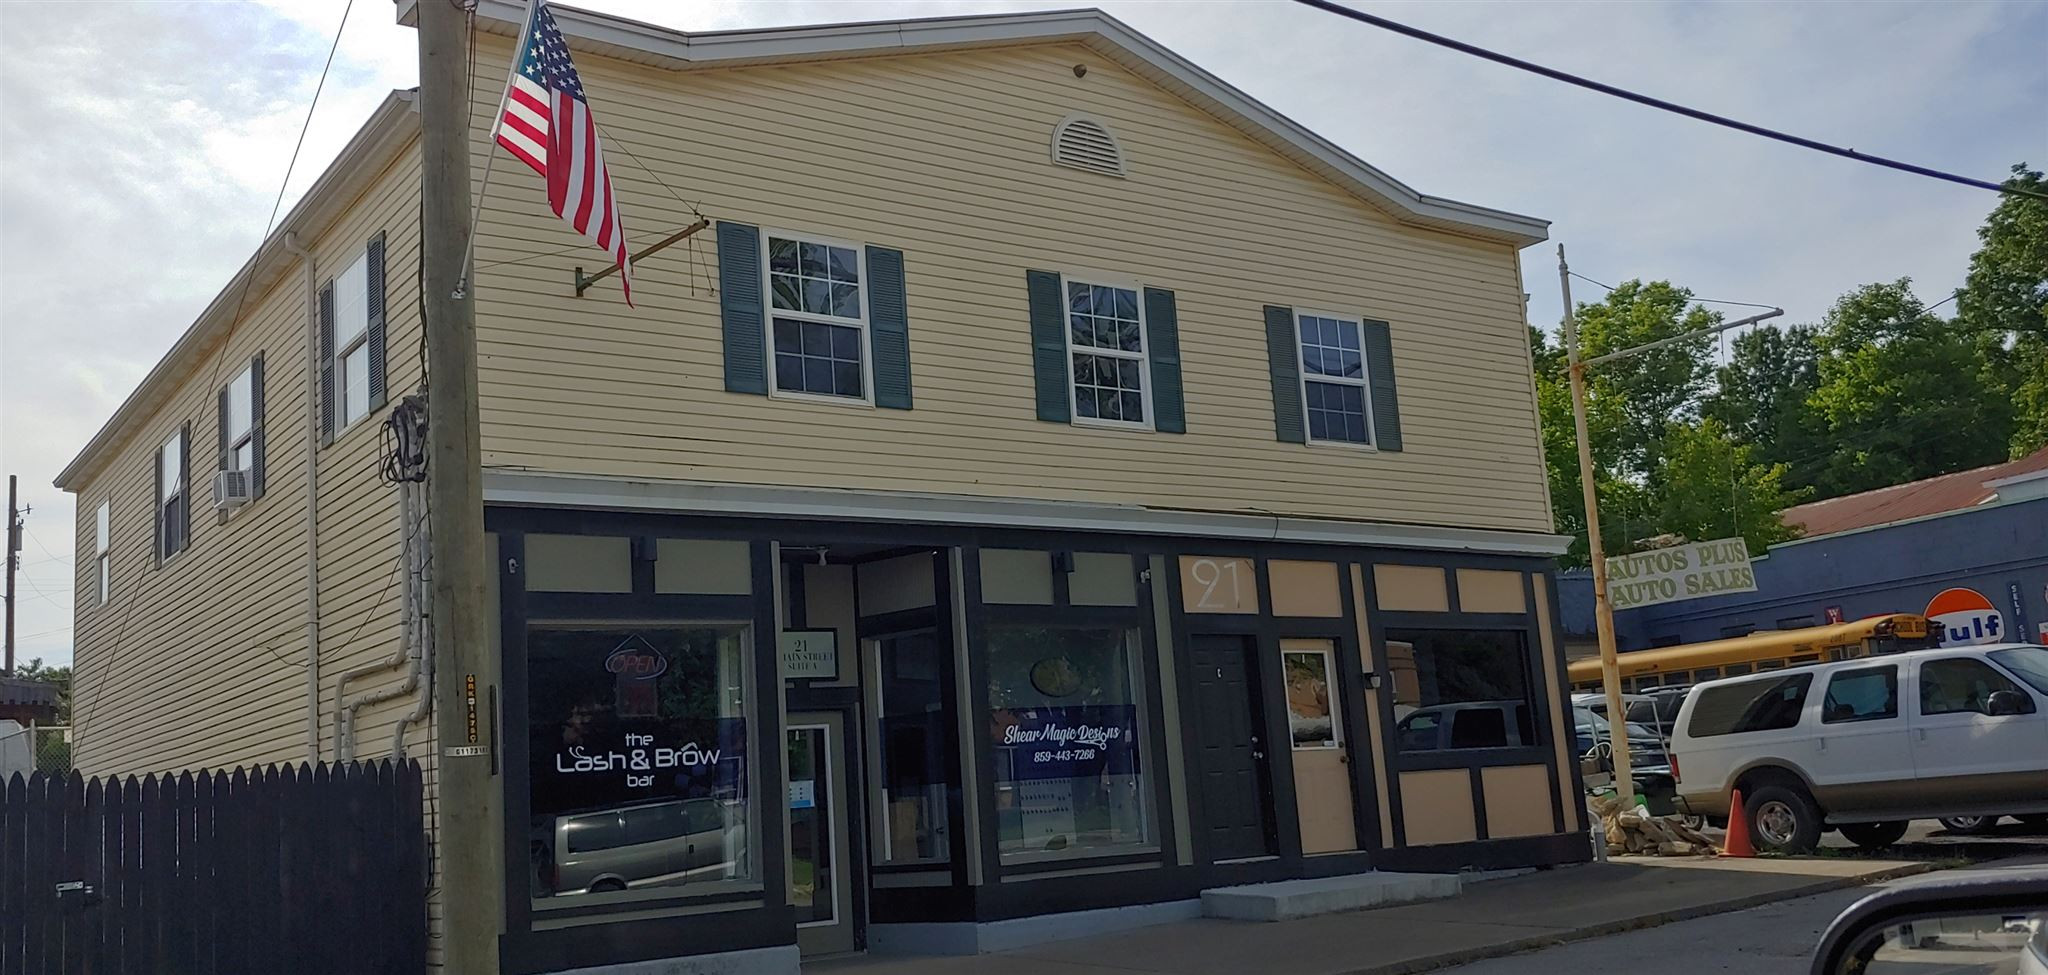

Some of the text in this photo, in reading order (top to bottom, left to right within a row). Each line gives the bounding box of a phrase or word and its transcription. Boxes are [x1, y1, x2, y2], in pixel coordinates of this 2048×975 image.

[1607, 542, 1746, 581] AUTOS PLUS
[1191, 559, 1241, 609] 21
[1611, 567, 1754, 607] AUTO SALES
[2010, 584, 2021, 616] SELF
[794, 640, 807, 652] 21
[610, 654, 662, 673] OPEN
[625, 732, 654, 747] the
[1003, 723, 1121, 750] Shear Magic Designs
[556, 745, 627, 773] Lash
[630, 751, 651, 771] &
[1033, 748, 1096, 763] 859-443-7266
[626, 773, 655, 788] bar
